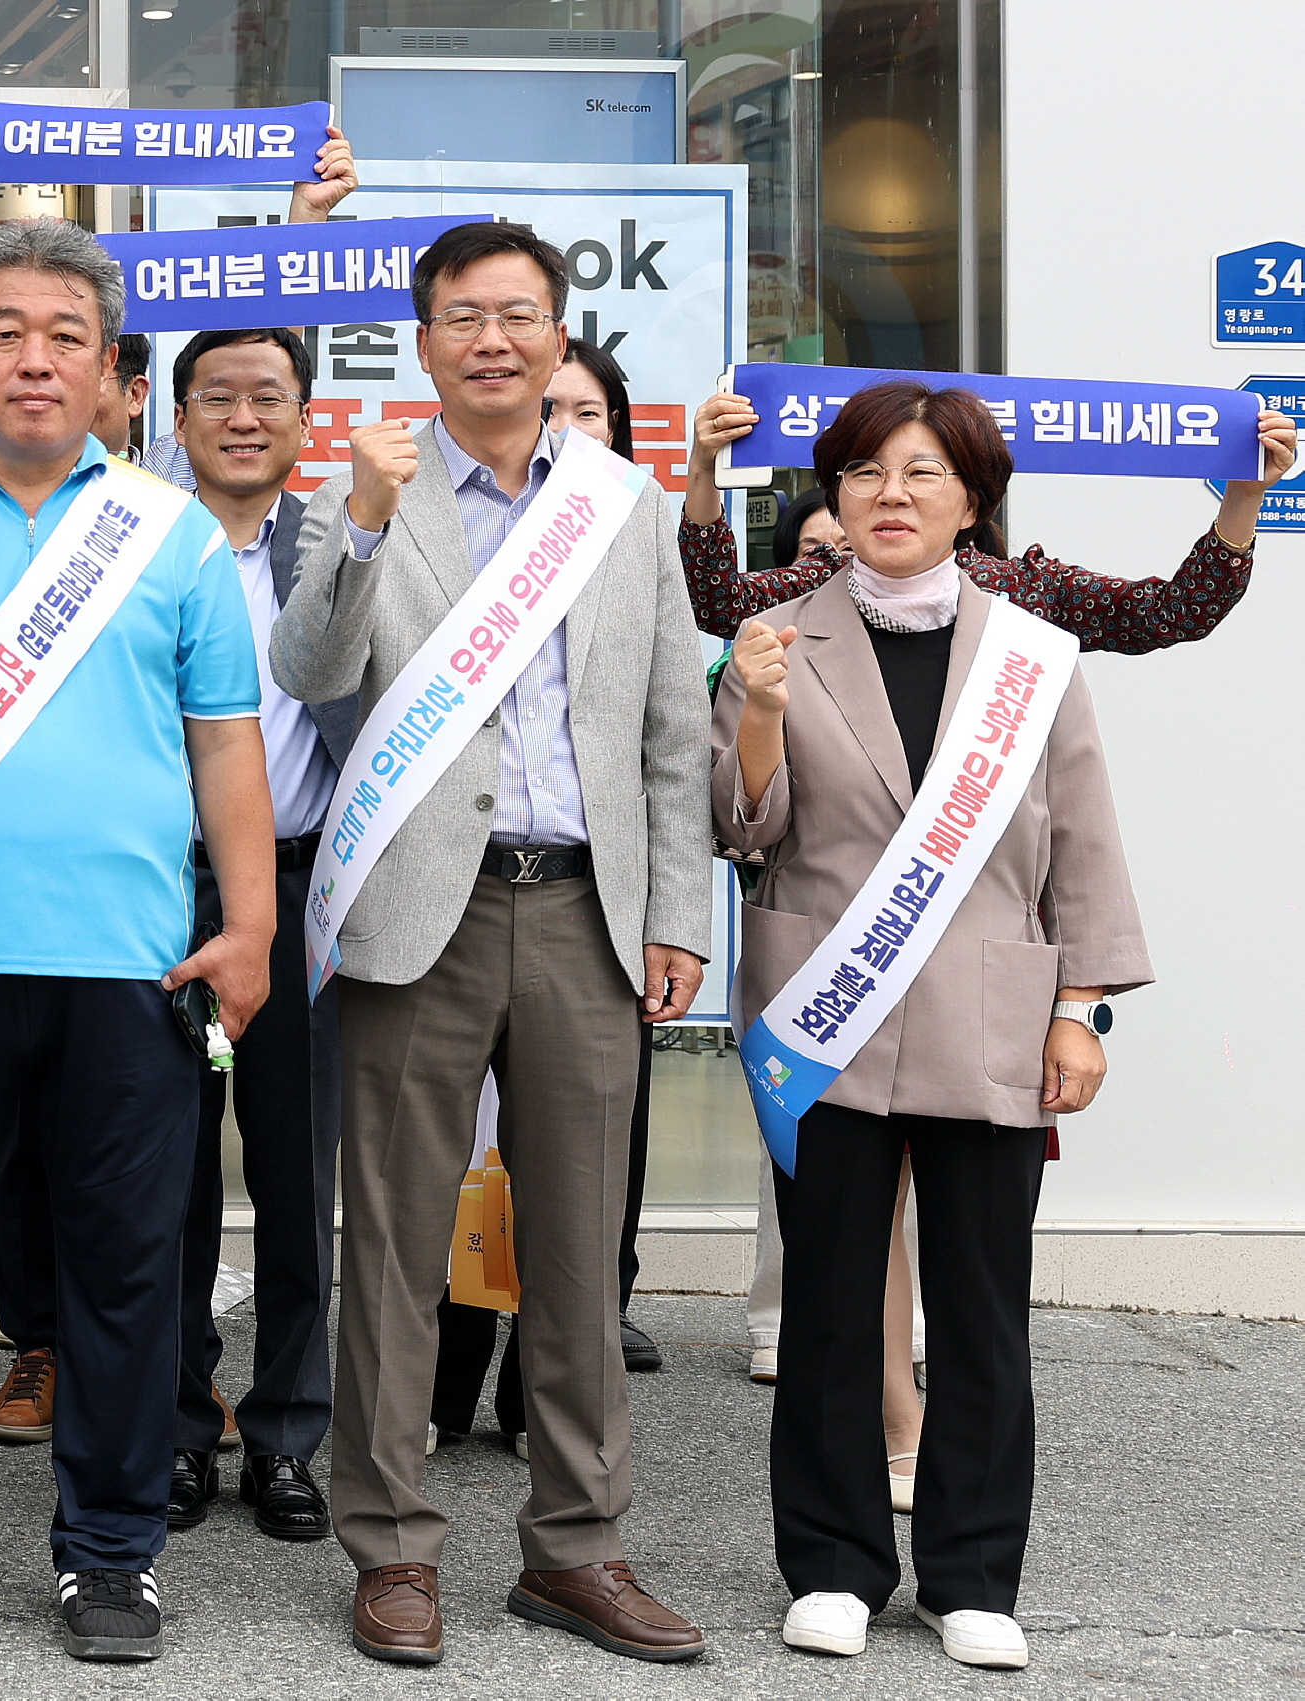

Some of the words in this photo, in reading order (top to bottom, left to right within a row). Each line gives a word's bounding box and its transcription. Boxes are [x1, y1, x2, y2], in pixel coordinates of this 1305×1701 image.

[4, 121, 122, 155] 여러분
[135, 122, 295, 158] 힘내세요
[586, 98, 604, 112] SK
[607, 103, 651, 114] telecom
[136, 254, 265, 300] 여러분
[278, 246, 414, 295] 힘내세
[1224, 308, 1266, 323] 영랑로
[1224, 324, 1294, 336] Yeongnang-ro
[1030, 400, 1219, 445] 힘내세요
[81, 499, 141, 560] 배달은
[510, 492, 596, 611] 소상공인이
[16, 548, 111, 660] 공공배달앱
[450, 601, 520, 685] 웃어야
[371, 673, 465, 788] 강진군이
[975, 650, 1045, 757] 강진상가
[330, 785, 382, 868] 웃는다
[920, 750, 1004, 866] 이용으로
[850, 856, 945, 974] 지역경제
[791, 961, 877, 1046] 활성화
